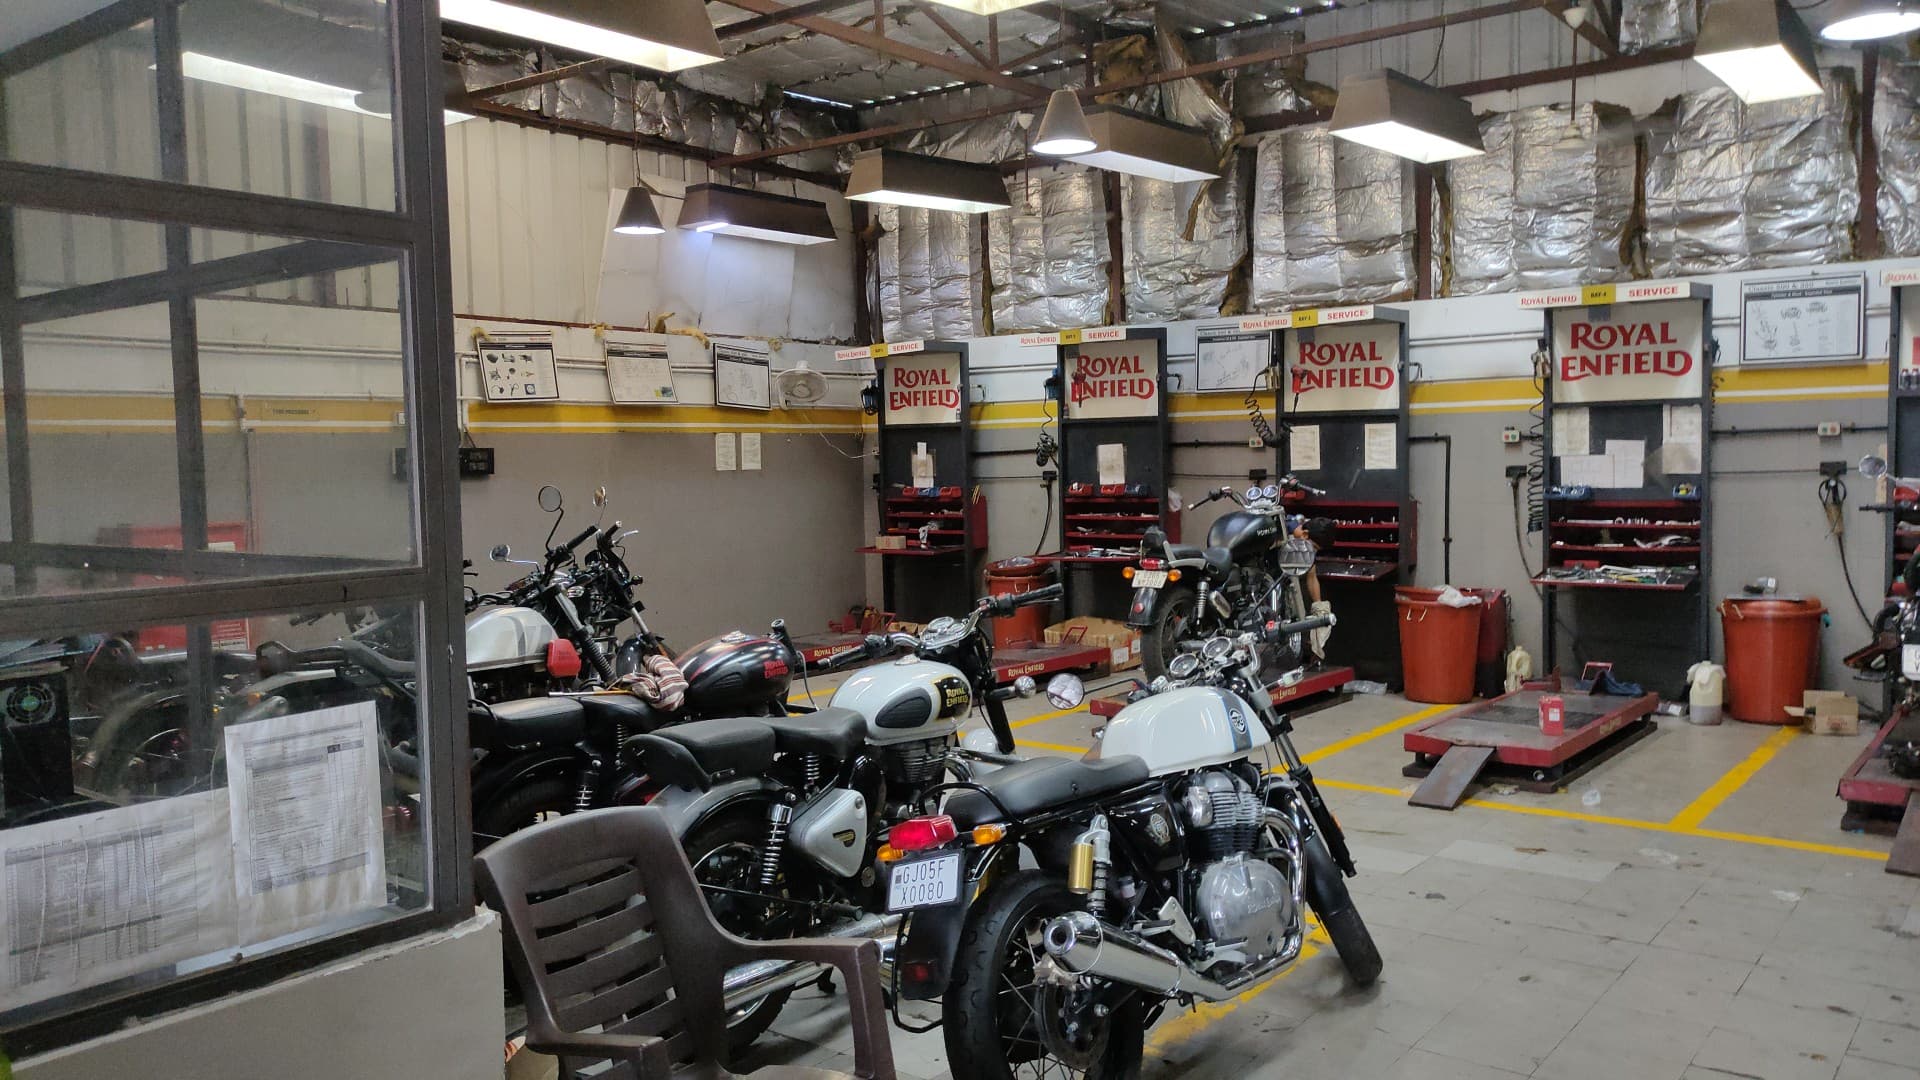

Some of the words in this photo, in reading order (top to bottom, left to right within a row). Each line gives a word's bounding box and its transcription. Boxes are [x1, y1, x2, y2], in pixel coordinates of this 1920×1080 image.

[1629, 285, 1679, 298] SERVICE
[1521, 297, 1545, 306] ROYAL
[1547, 295, 1577, 304] ENFIELD
[1327, 309, 1365, 320] SERVICE
[1242, 321, 1263, 329] ROYAL
[1263, 318, 1288, 327] ENFIELD
[1088, 330, 1119, 339] SERVICE
[1571, 322, 1678, 351] ROYAL
[892, 343, 918, 352] SERVICE
[1299, 340, 1383, 366] ROYAL
[1075, 355, 1145, 378] ROYAL
[1561, 350, 1693, 382] ENFIELD
[893, 367, 951, 389] ROYAL
[889, 389, 960, 411] ENFIELD
[814, 648, 831, 657] ROYAL
[764, 660, 785, 670] ROYAL
[1008, 667, 1025, 677] ROYAL
[1024, 663, 1045, 674] ENFIELD
[946, 688, 964, 698] ROYAL
[903, 860, 945, 884] GJ05F
[900, 881, 944, 905] X0080
